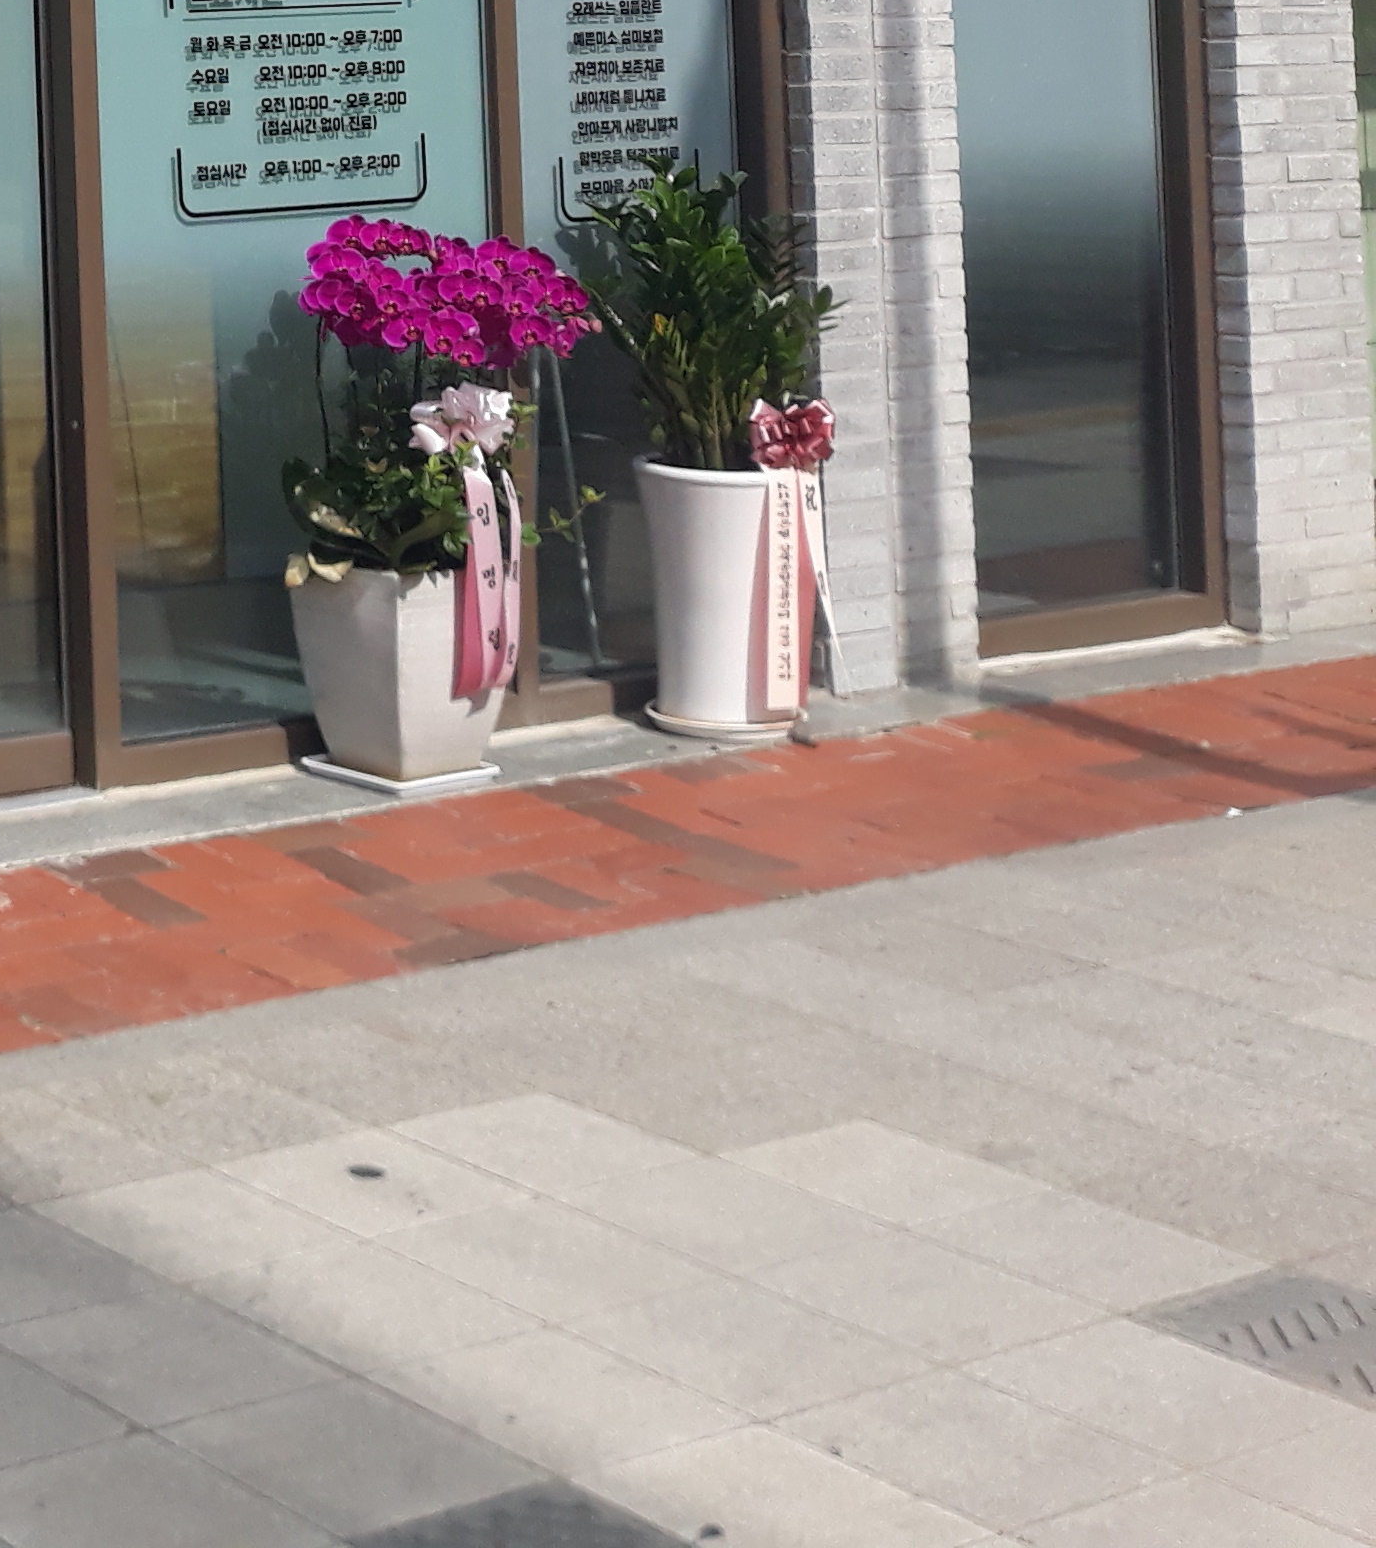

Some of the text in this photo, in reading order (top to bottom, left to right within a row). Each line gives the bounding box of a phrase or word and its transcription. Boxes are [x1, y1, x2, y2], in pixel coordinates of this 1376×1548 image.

[572, 0, 617, 17] 오래쓰는
[205, 36, 220, 52] 화
[223, 35, 236, 52] 목
[239, 35, 252, 50] 금
[257, 33, 284, 50] 오전
[285, 32, 327, 49] 10:00
[342, 29, 369, 46] 오후
[369, 28, 404, 44] 7:00
[191, 67, 230, 85] 수요일
[258, 65, 285, 82] 오전
[286, 63, 328, 80] 10:00
[344, 61, 370, 78] 오후
[574, 58, 666, 77] 자연치아 보존치료
[192, 99, 232, 118] 토요일
[260, 96, 287, 114] 오전
[288, 95, 329, 112] 10:00
[345, 92, 371, 109] 오후
[373, 90, 408, 106] 2:00
[262, 114, 379, 138] (점심시간 없이 진료)
[196, 163, 248, 182] 점심시간
[264, 160, 290, 178] 오후
[291, 158, 323, 175] 1:00
[339, 156, 365, 173] 오후
[366, 153, 402, 170] 2:00
